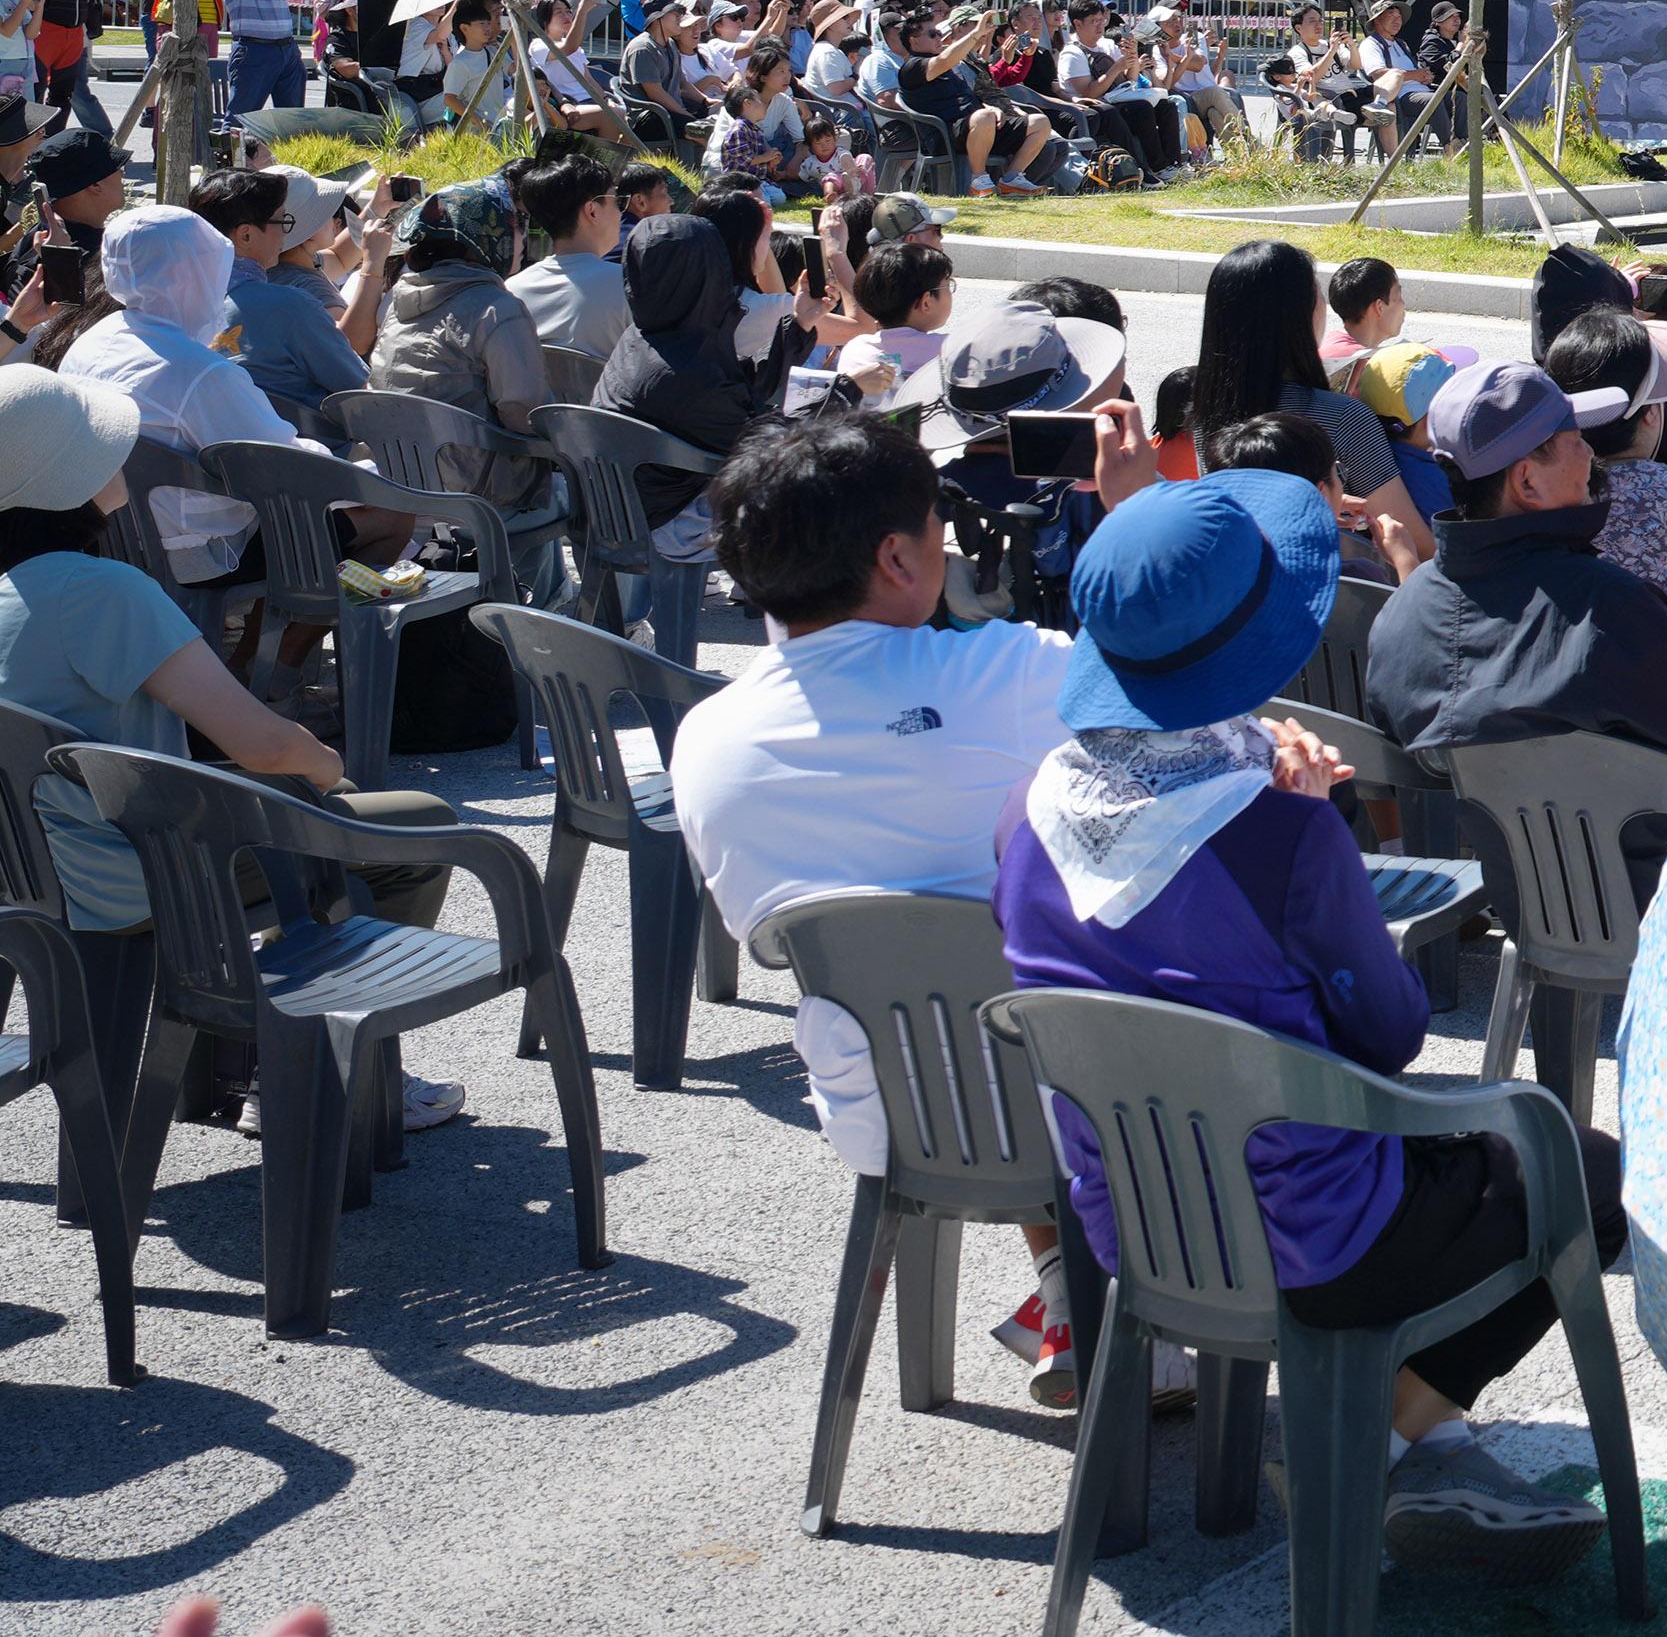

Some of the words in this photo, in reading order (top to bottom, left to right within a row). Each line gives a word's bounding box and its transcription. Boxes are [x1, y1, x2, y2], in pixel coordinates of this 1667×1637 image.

[900, 706, 921, 717] THE
[886, 715, 922, 732] NORTH
[897, 723, 922, 737] FACE
